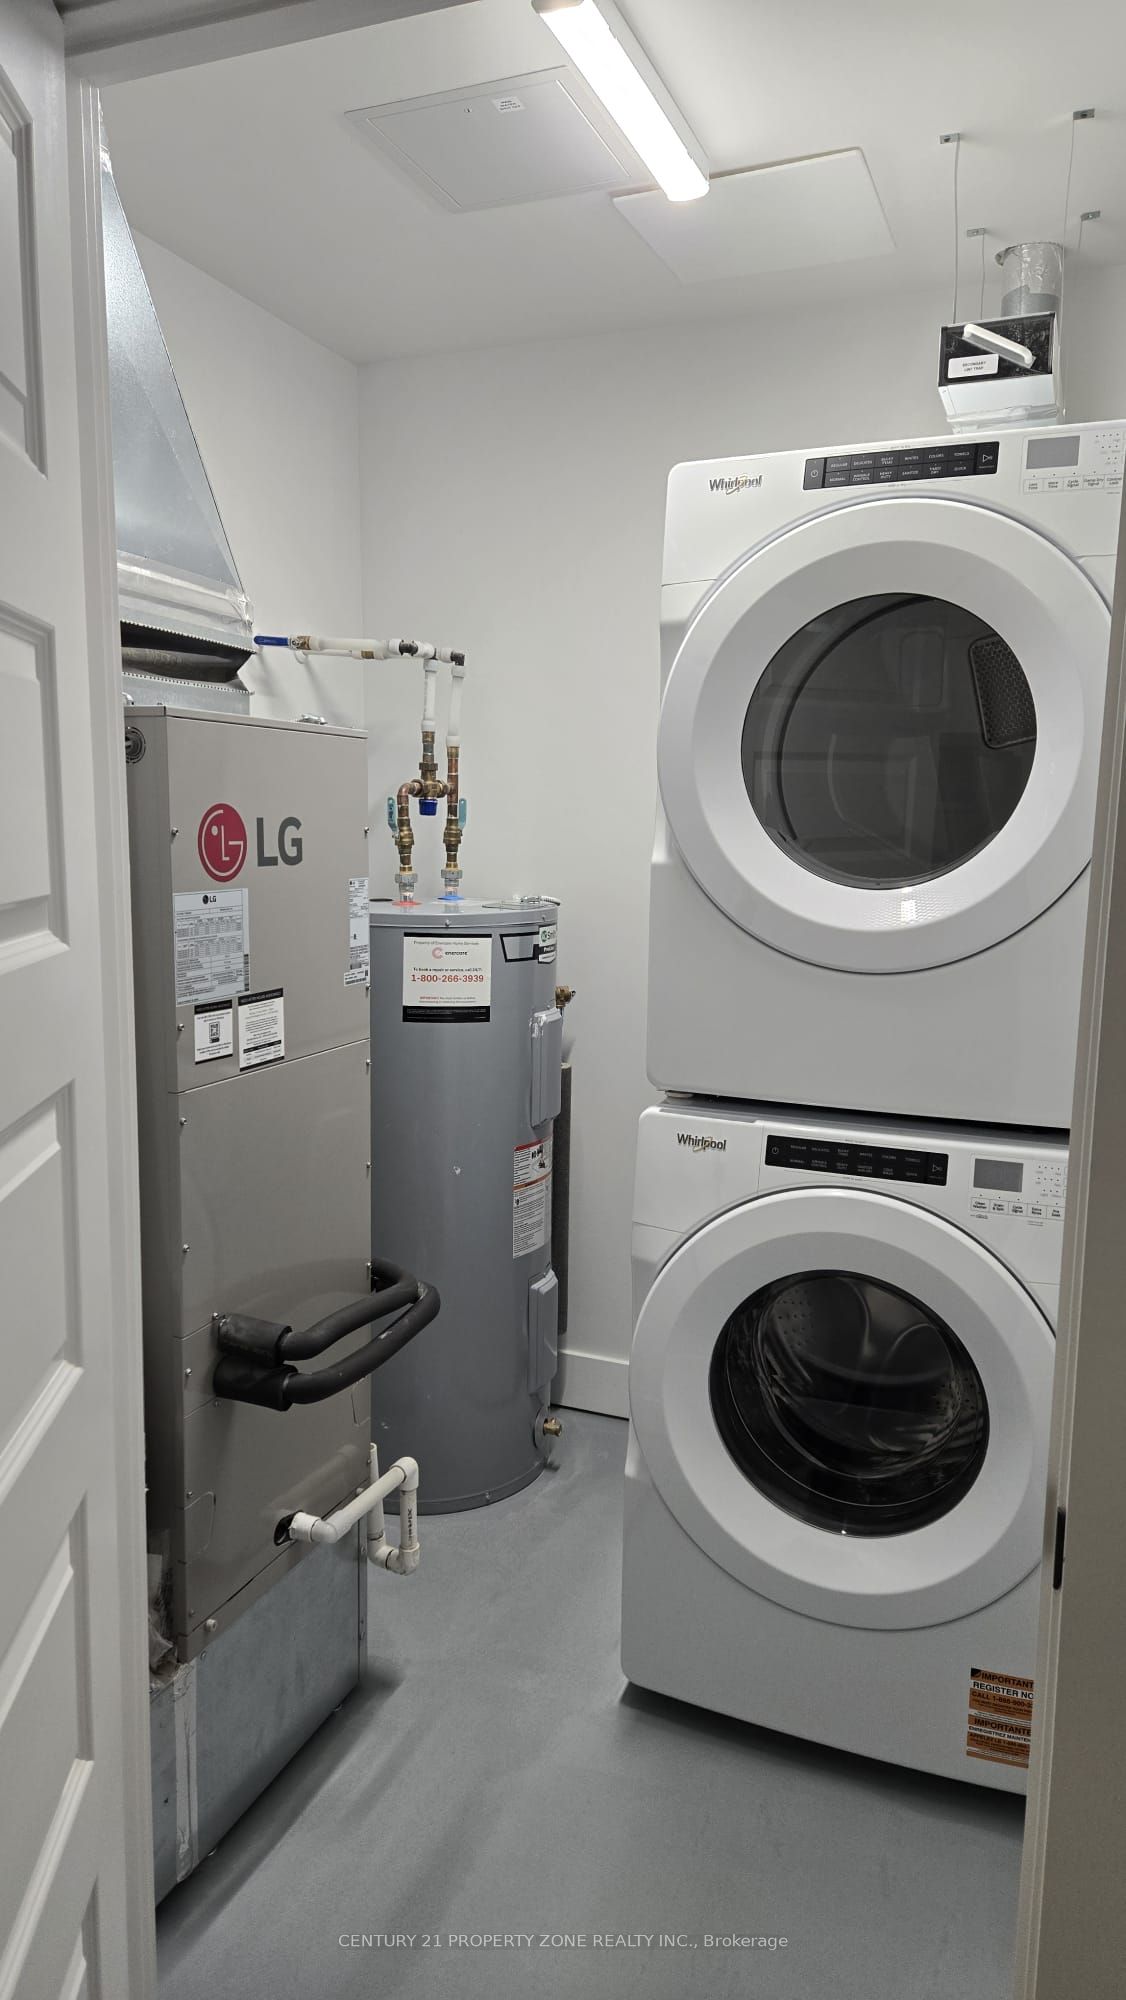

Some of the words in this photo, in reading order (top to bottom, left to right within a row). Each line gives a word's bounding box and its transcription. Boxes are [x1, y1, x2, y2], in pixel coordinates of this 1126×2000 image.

[709, 474, 763, 495] Whirlpool
[256, 816, 303, 867] LG
[411, 974, 484, 983] 1-800-266-3939
[677, 1133, 727, 1152] Whirlpool
[982, 1671, 1034, 1689] IMPORTANT
[971, 1691, 990, 1700] CALL
[973, 1681, 1019, 1698] REGISTER
